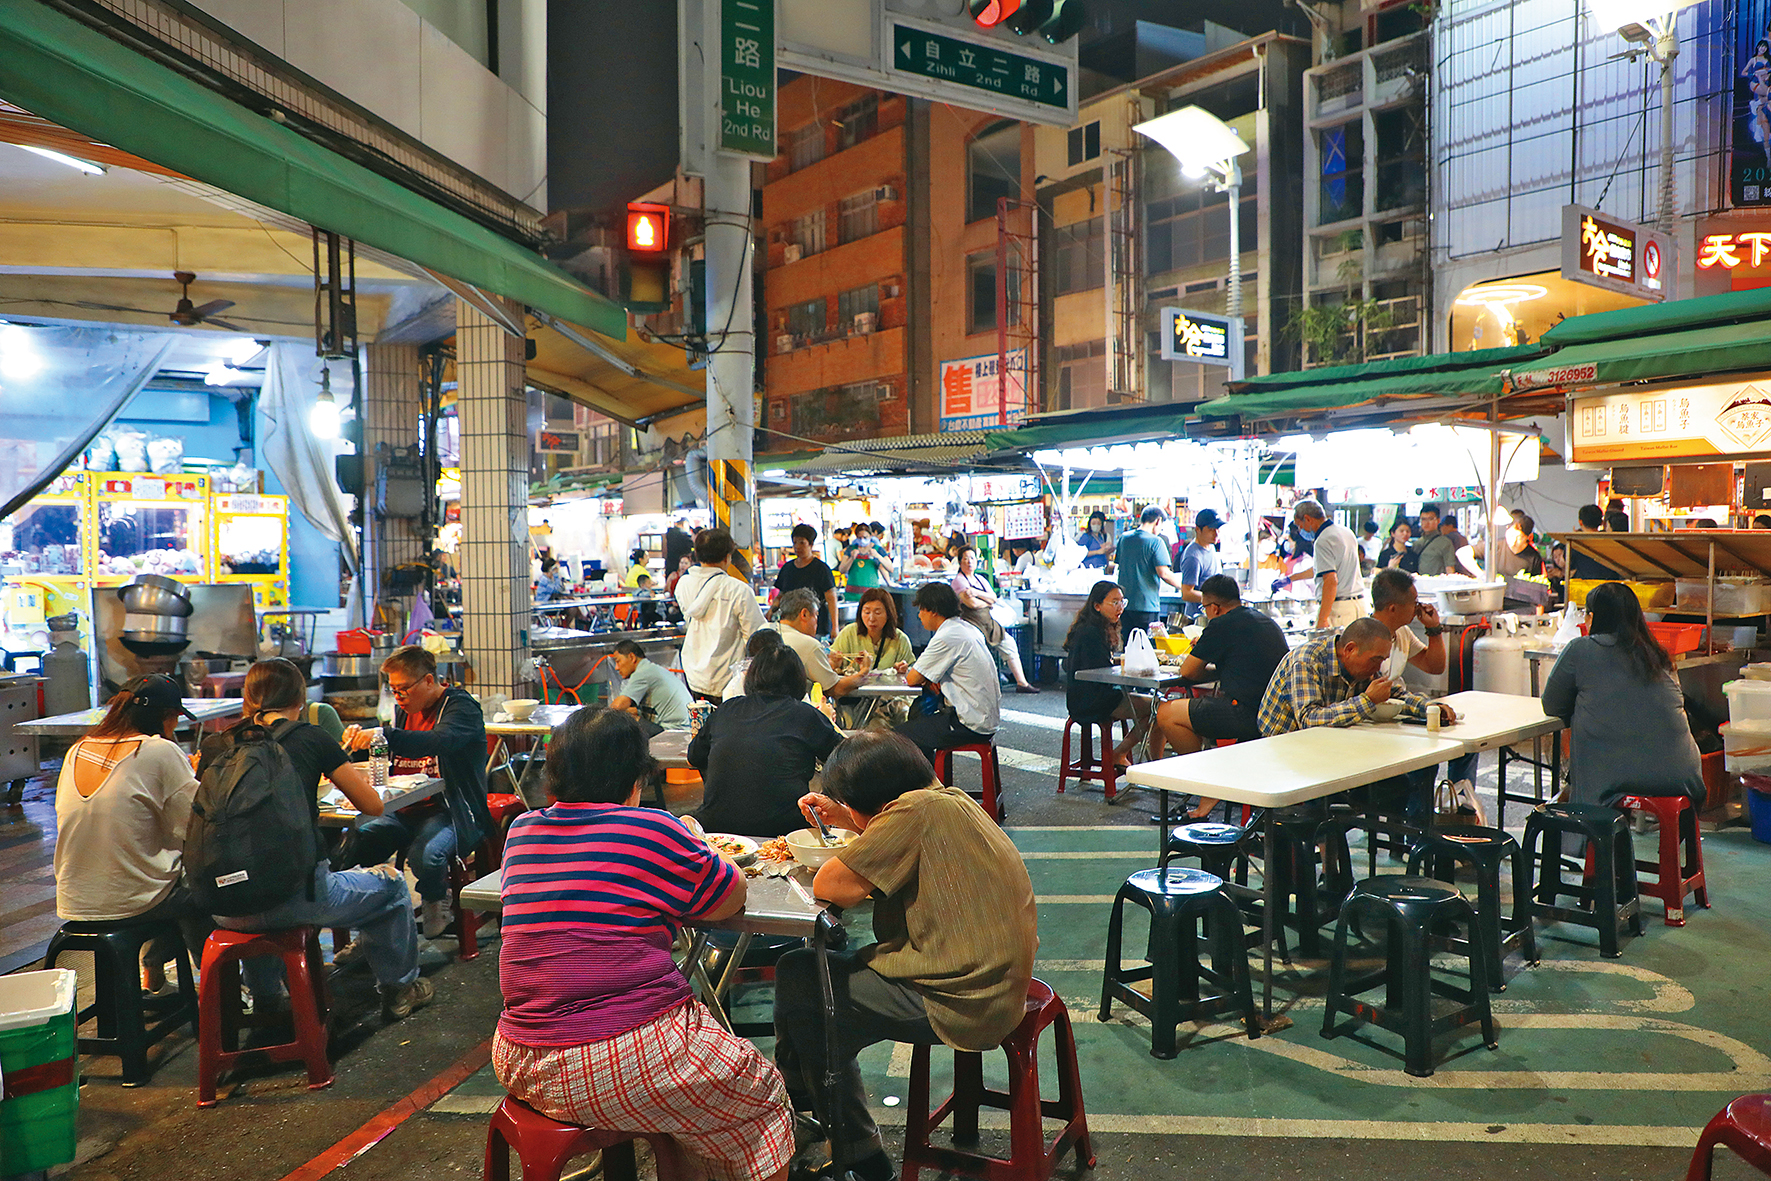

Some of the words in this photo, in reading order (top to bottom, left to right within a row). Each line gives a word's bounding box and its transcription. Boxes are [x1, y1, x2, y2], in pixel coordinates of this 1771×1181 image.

[925, 39, 1040, 84] 自立二路
[926, 61, 956, 77] Zihli
[976, 73, 1002, 88] 2nd
[730, 78, 766, 98] Liou
[736, 100, 761, 118] He
[724, 119, 748, 137] 2nd
[1548, 366, 1595, 383] 3126952
[944, 365, 973, 415] 售
